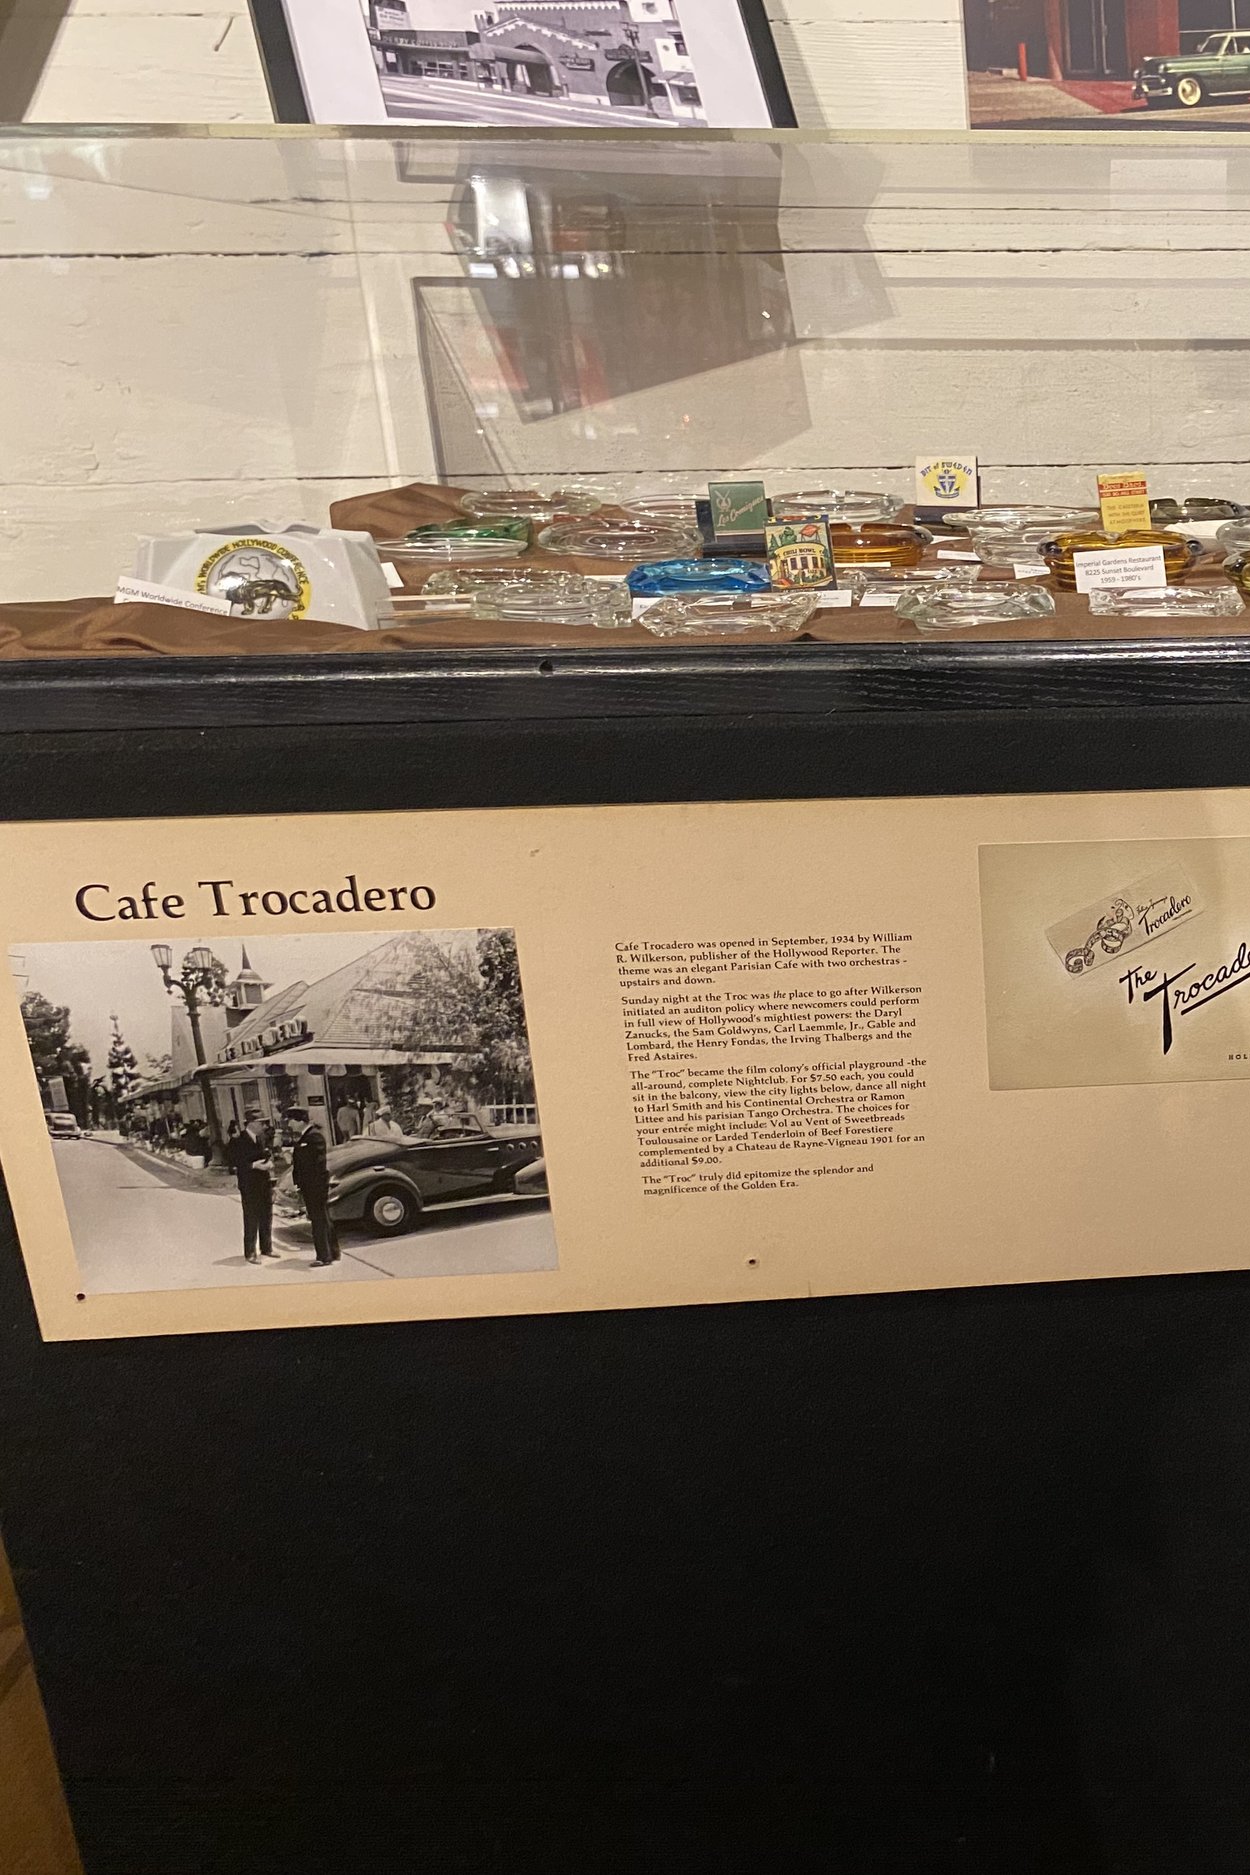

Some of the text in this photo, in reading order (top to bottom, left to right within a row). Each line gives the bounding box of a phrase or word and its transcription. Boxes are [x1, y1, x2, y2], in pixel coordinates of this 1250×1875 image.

[232, 539, 278, 551] HOLLYWOOD
[1076, 554, 1162, 570] Imperial Gardens Restaurant
[1102, 565, 1123, 575] Sunset
[1123, 564, 1155, 574] Boulevard
[1100, 576, 1116, 585] 1959
[117, 586, 229, 615] MGM Worldwide Conference
[75, 876, 437, 922] Cafe Trocadero
[1138, 895, 1192, 936] Trocadero
[614, 941, 639, 952] Cafe
[639, 939, 694, 950] Trocadero
[718, 937, 755, 949] opened
[757, 937, 769, 946] in
[830, 934, 855, 944] 1934
[856, 933, 870, 945] by
[871, 932, 912, 942] William
[688, 950, 738, 963] publisher
[739, 949, 751, 959] of
[753, 948, 771, 959] the
[772, 946, 829, 959] Hollywood
[879, 944, 901, 954] The
[620, 984, 922, 1006] Sunday night at the Troc was the place to go after Wilkerson
[1119, 966, 1157, 1004] The
[672, 1027, 690, 1037] the
[691, 1027, 715, 1037] Sam
[772, 1022, 796, 1033] Carl
[865, 1018, 896, 1029] Gable
[897, 1017, 916, 1027] and
[687, 1077, 733, 1089] complete
[789, 1074, 808, 1083] For
[866, 1072, 886, 1081] you
[886, 1068, 914, 1078] could
[633, 1105, 644, 1113] to
[671, 1101, 703, 1111] Smith
[703, 1099, 724, 1110] and
[725, 1099, 742, 1109] his
[742, 1096, 803, 1108] Continental
[804, 1094, 855, 1104] Orchestra
[856, 1094, 869, 1102] or
[869, 1092, 905, 1101] Ramon
[642, 1184, 707, 1196] magnificence
[708, 1182, 720, 1191] of
[722, 1181, 739, 1191] the
[740, 1179, 777, 1190] Golden
